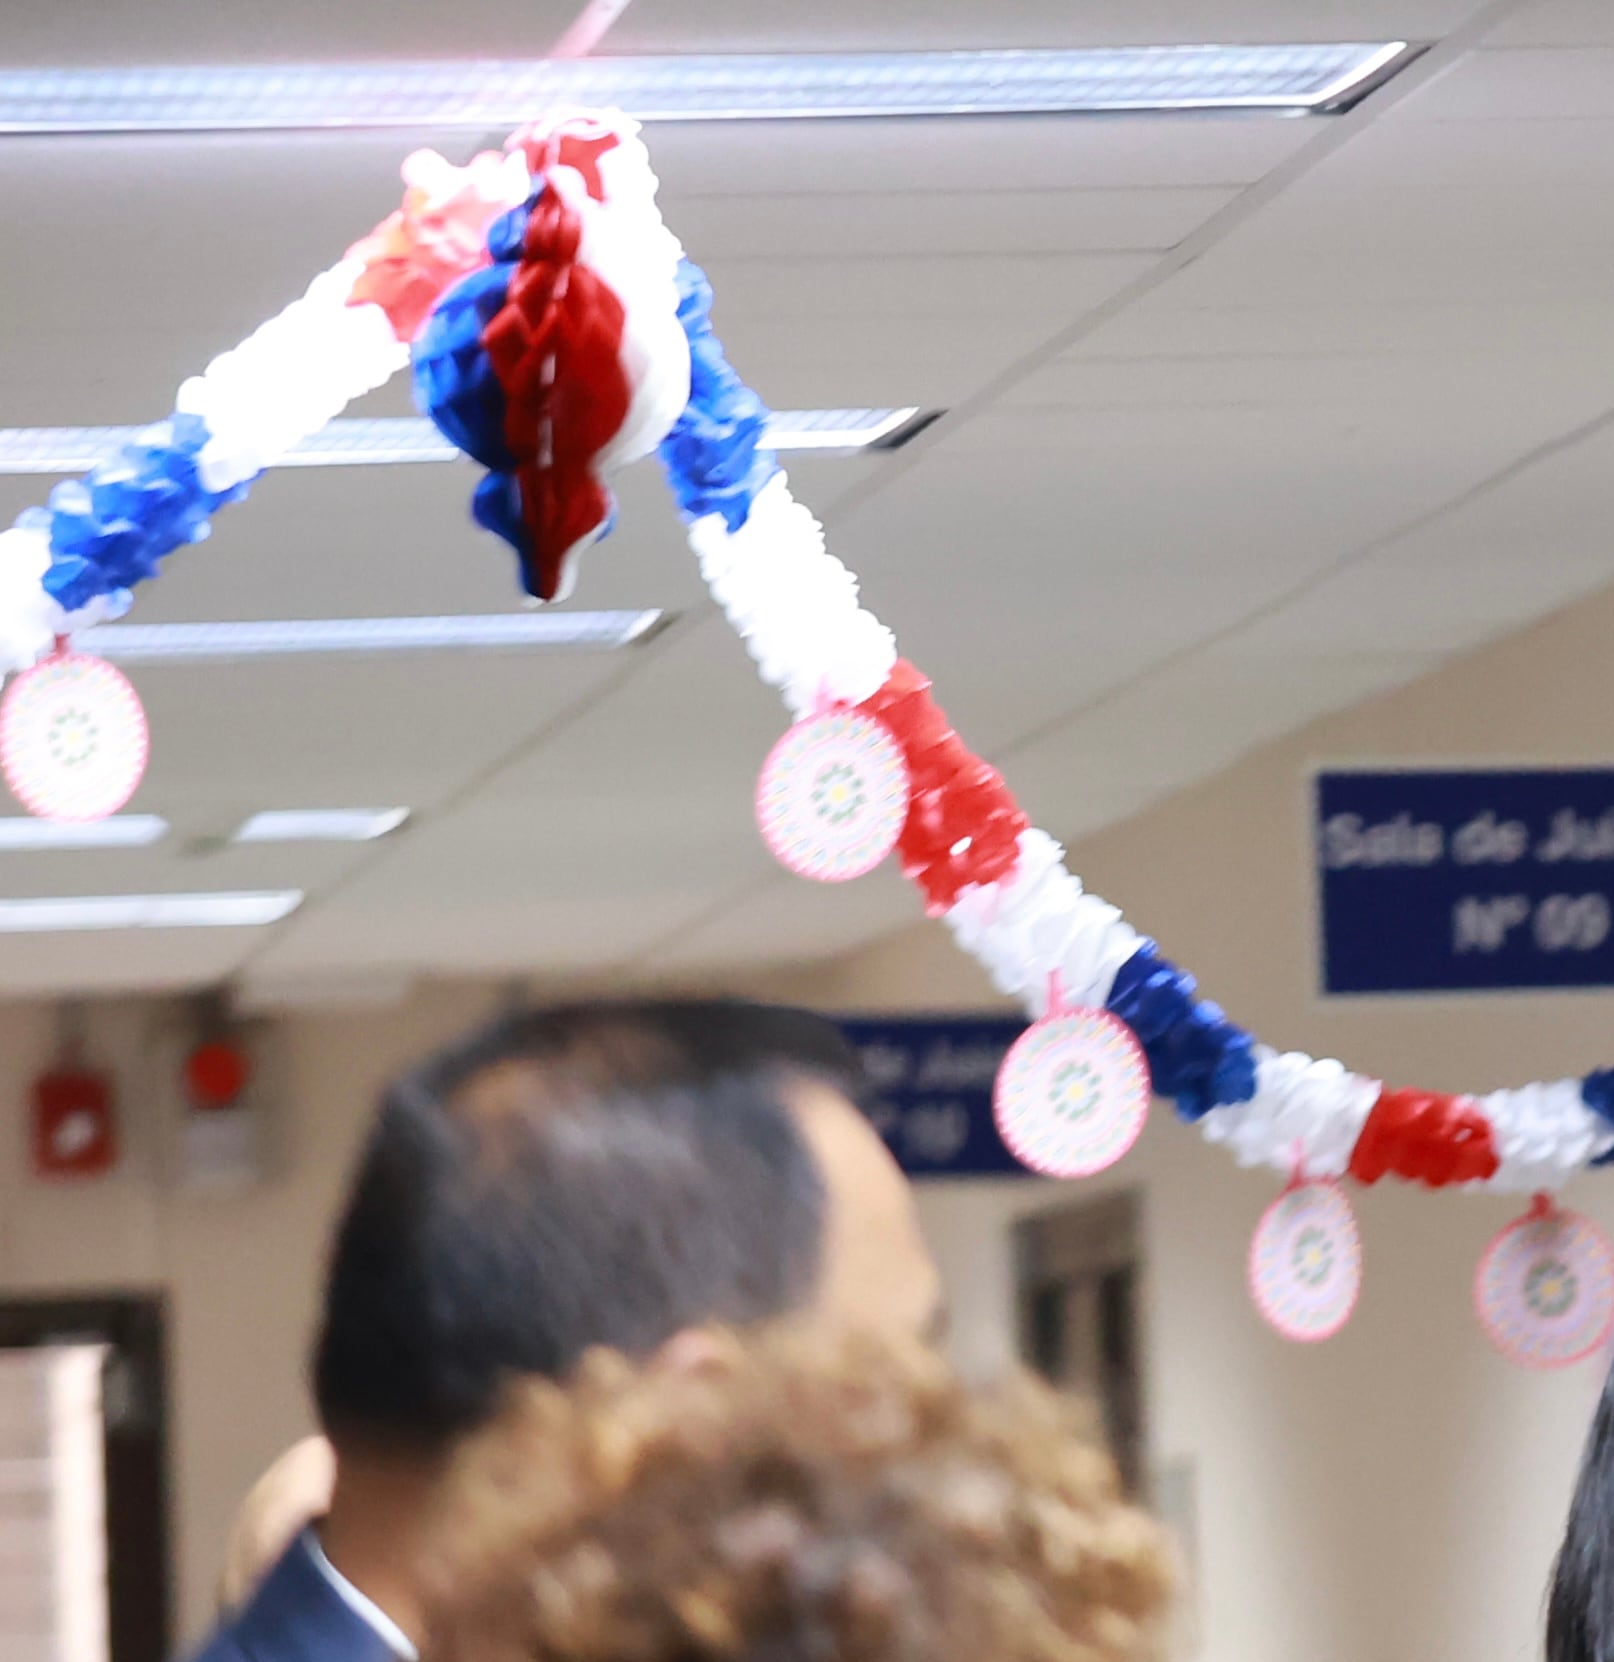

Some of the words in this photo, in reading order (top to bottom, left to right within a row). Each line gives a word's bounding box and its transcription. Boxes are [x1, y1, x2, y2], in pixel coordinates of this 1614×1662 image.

[1323, 811, 1443, 869] Sala
[1452, 808, 1528, 866] de
[1533, 892, 1612, 952] 09
